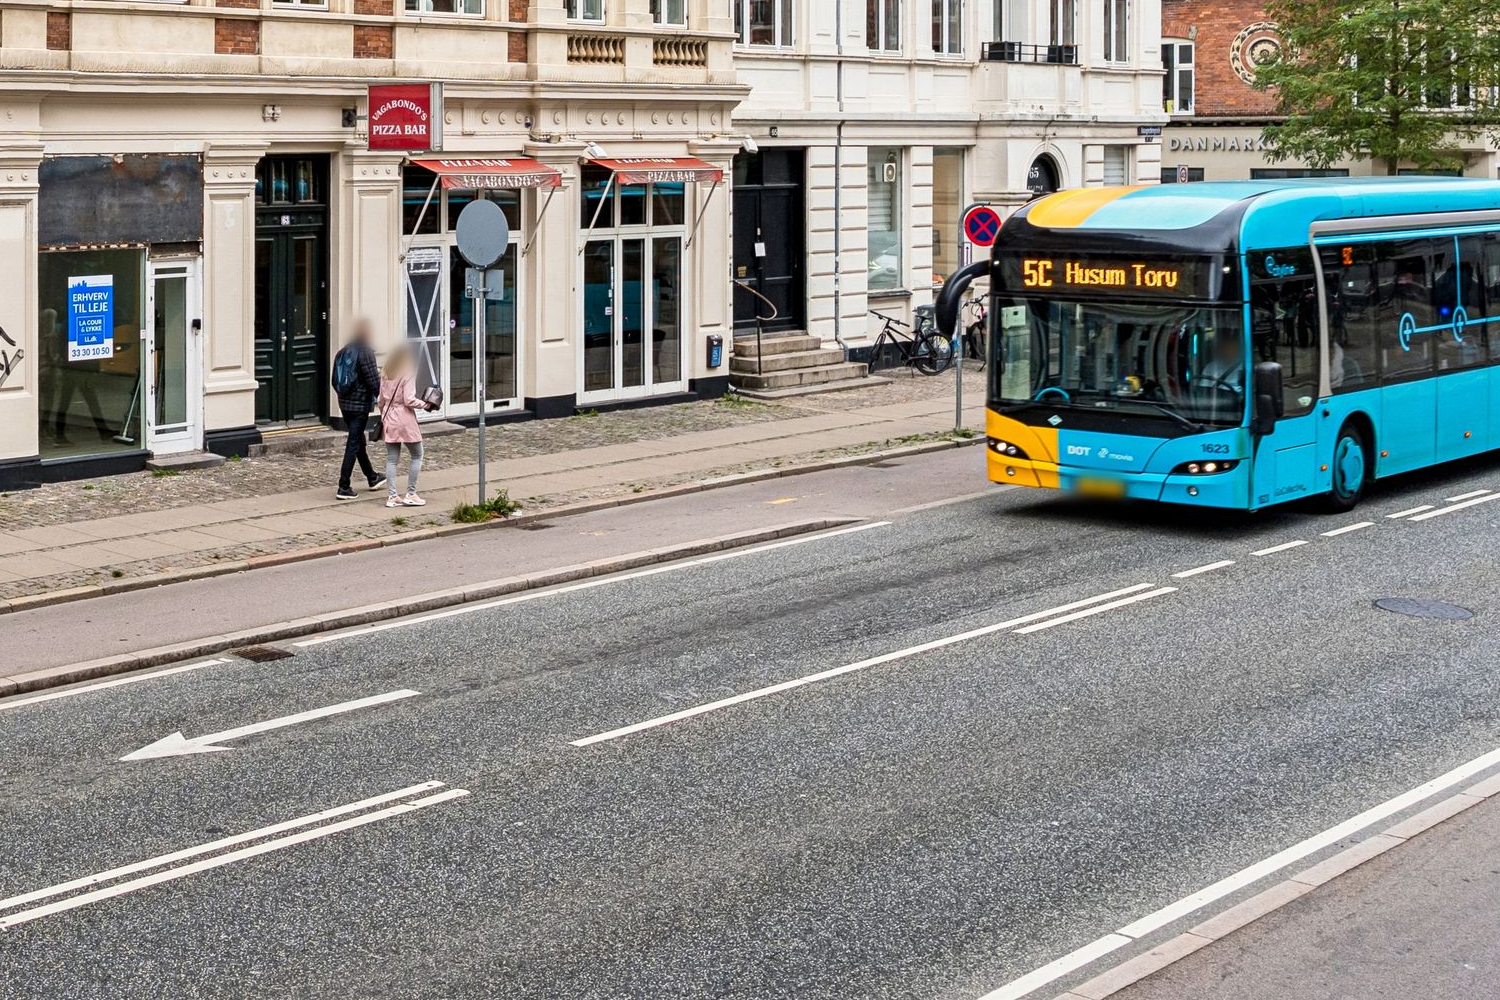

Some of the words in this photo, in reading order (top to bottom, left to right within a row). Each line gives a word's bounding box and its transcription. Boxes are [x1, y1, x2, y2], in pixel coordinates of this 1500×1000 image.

[372, 99, 428, 121] VAGABONDO'S
[372, 124, 402, 135] PIZZA
[404, 124, 427, 135] BAR
[1170, 135, 1267, 151] DANMARK
[647, 172, 674, 182] PIZZA
[677, 172, 696, 181] BAR
[1030, 167, 1040, 179] 65
[462, 175, 540, 188] VAGABONDO'S
[1023, 260, 1053, 287] 5C
[1066, 262, 1126, 286] Husum
[1131, 264, 1178, 288] Torv
[72, 292, 109, 302] ERHVERV
[72, 303, 87, 314] TIL
[88, 302, 108, 313] LEJE
[87, 318, 102, 326] COUR
[82, 348, 90, 356] 30
[101, 346, 110, 354] 50
[1067, 445, 1092, 456] DOT
[1201, 443, 1230, 454] 1623
